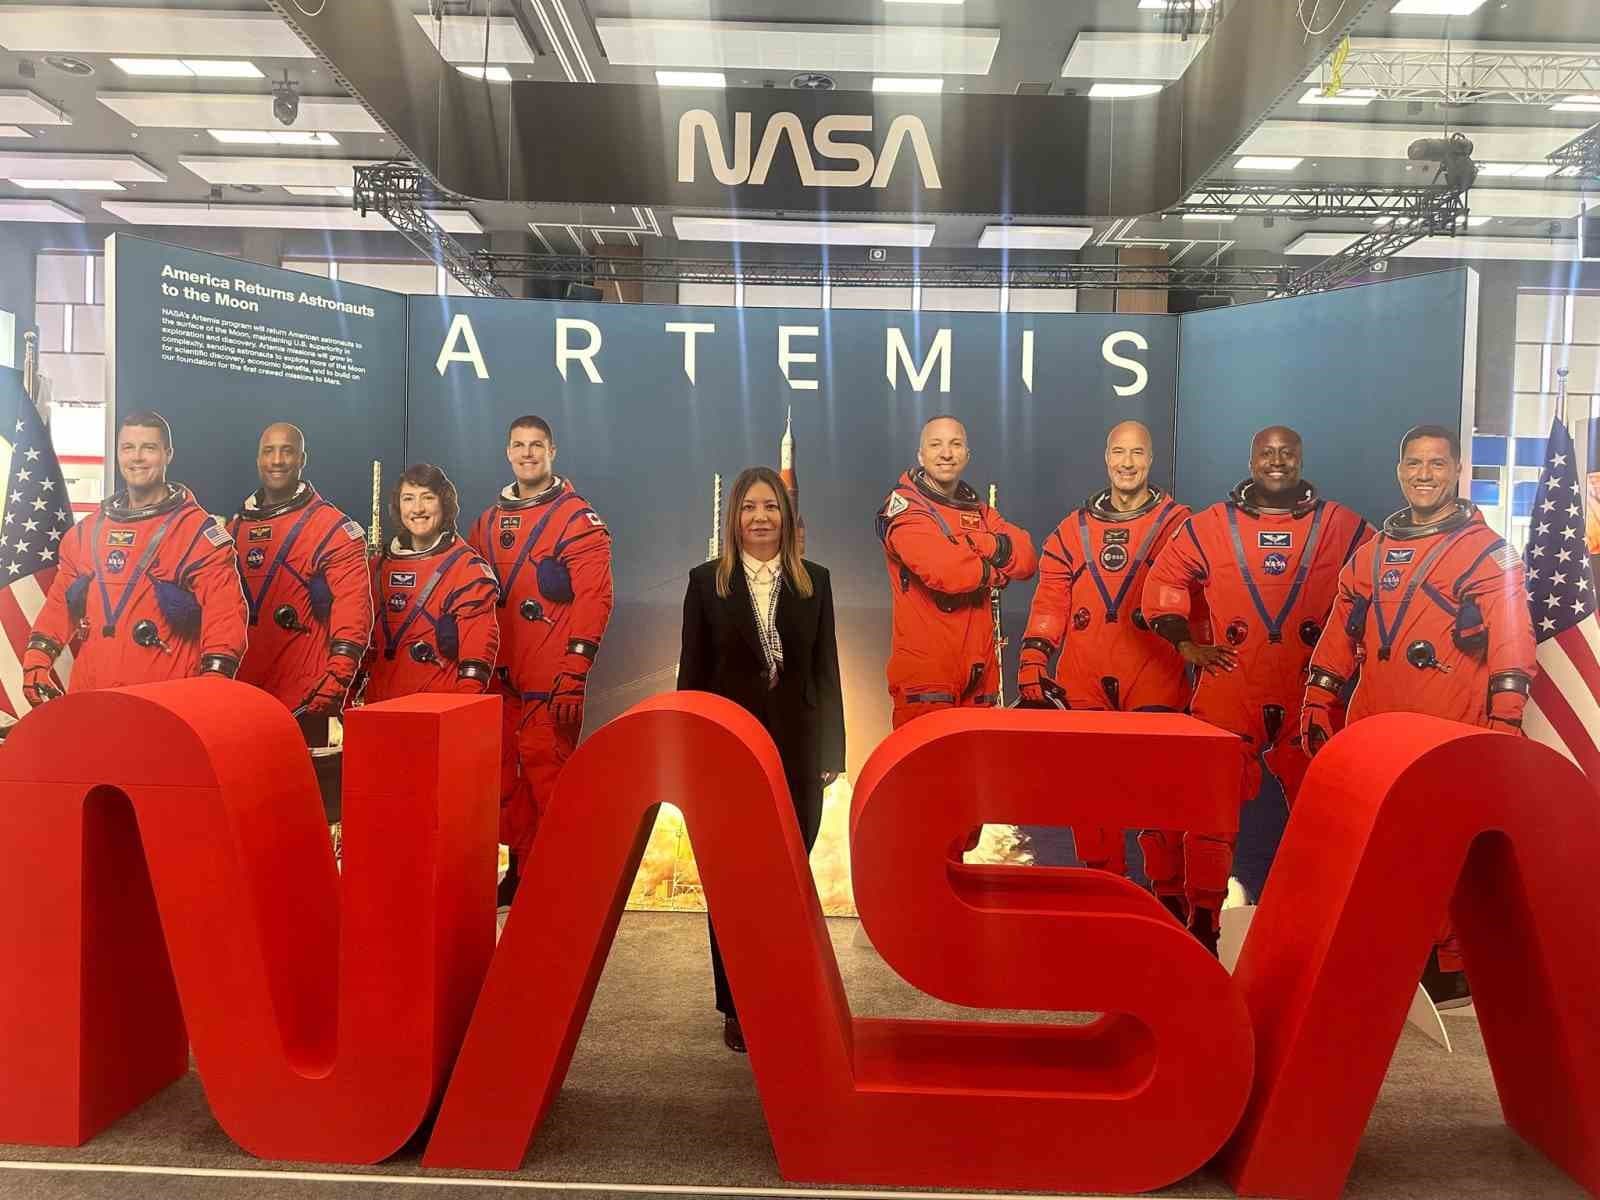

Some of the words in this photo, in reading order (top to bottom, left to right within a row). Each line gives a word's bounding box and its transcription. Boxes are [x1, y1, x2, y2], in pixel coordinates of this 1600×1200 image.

[678, 109, 942, 188] NASA
[162, 264, 230, 290] America
[234, 278, 295, 302] Returns
[298, 292, 375, 318] Astronauts
[162, 282, 178, 297] to
[183, 286, 210, 302] the
[215, 292, 259, 312] Moon
[162, 308, 190, 319] NASA's
[192, 314, 220, 324] Artemis
[221, 320, 252, 330] program
[266, 328, 287, 336] return
[288, 330, 320, 341] American
[321, 337, 354, 347] astronauts
[162, 327, 204, 339] exploration
[259, 342, 285, 352] Artemis
[287, 347, 316, 357] missions
[176, 320, 204, 330] surface
[228, 329, 250, 338] Moon,
[253, 333, 292, 346] maintaining
[175, 347, 208, 357] scientific
[247, 358, 281, 368] economic
[334, 370, 350, 378] build
[176, 355, 216, 367] foundation
[258, 367, 284, 376] crewed
[285, 372, 314, 380] missions
[206, 343, 235, 354] sending
[237, 348, 274, 358] astronauts
[284, 356, 308, 364] explore
[435, 314, 1149, 396] ARTEMIS
[1264, 560, 1286, 569] NASA
[0, 677, 1600, 1200] NASA
